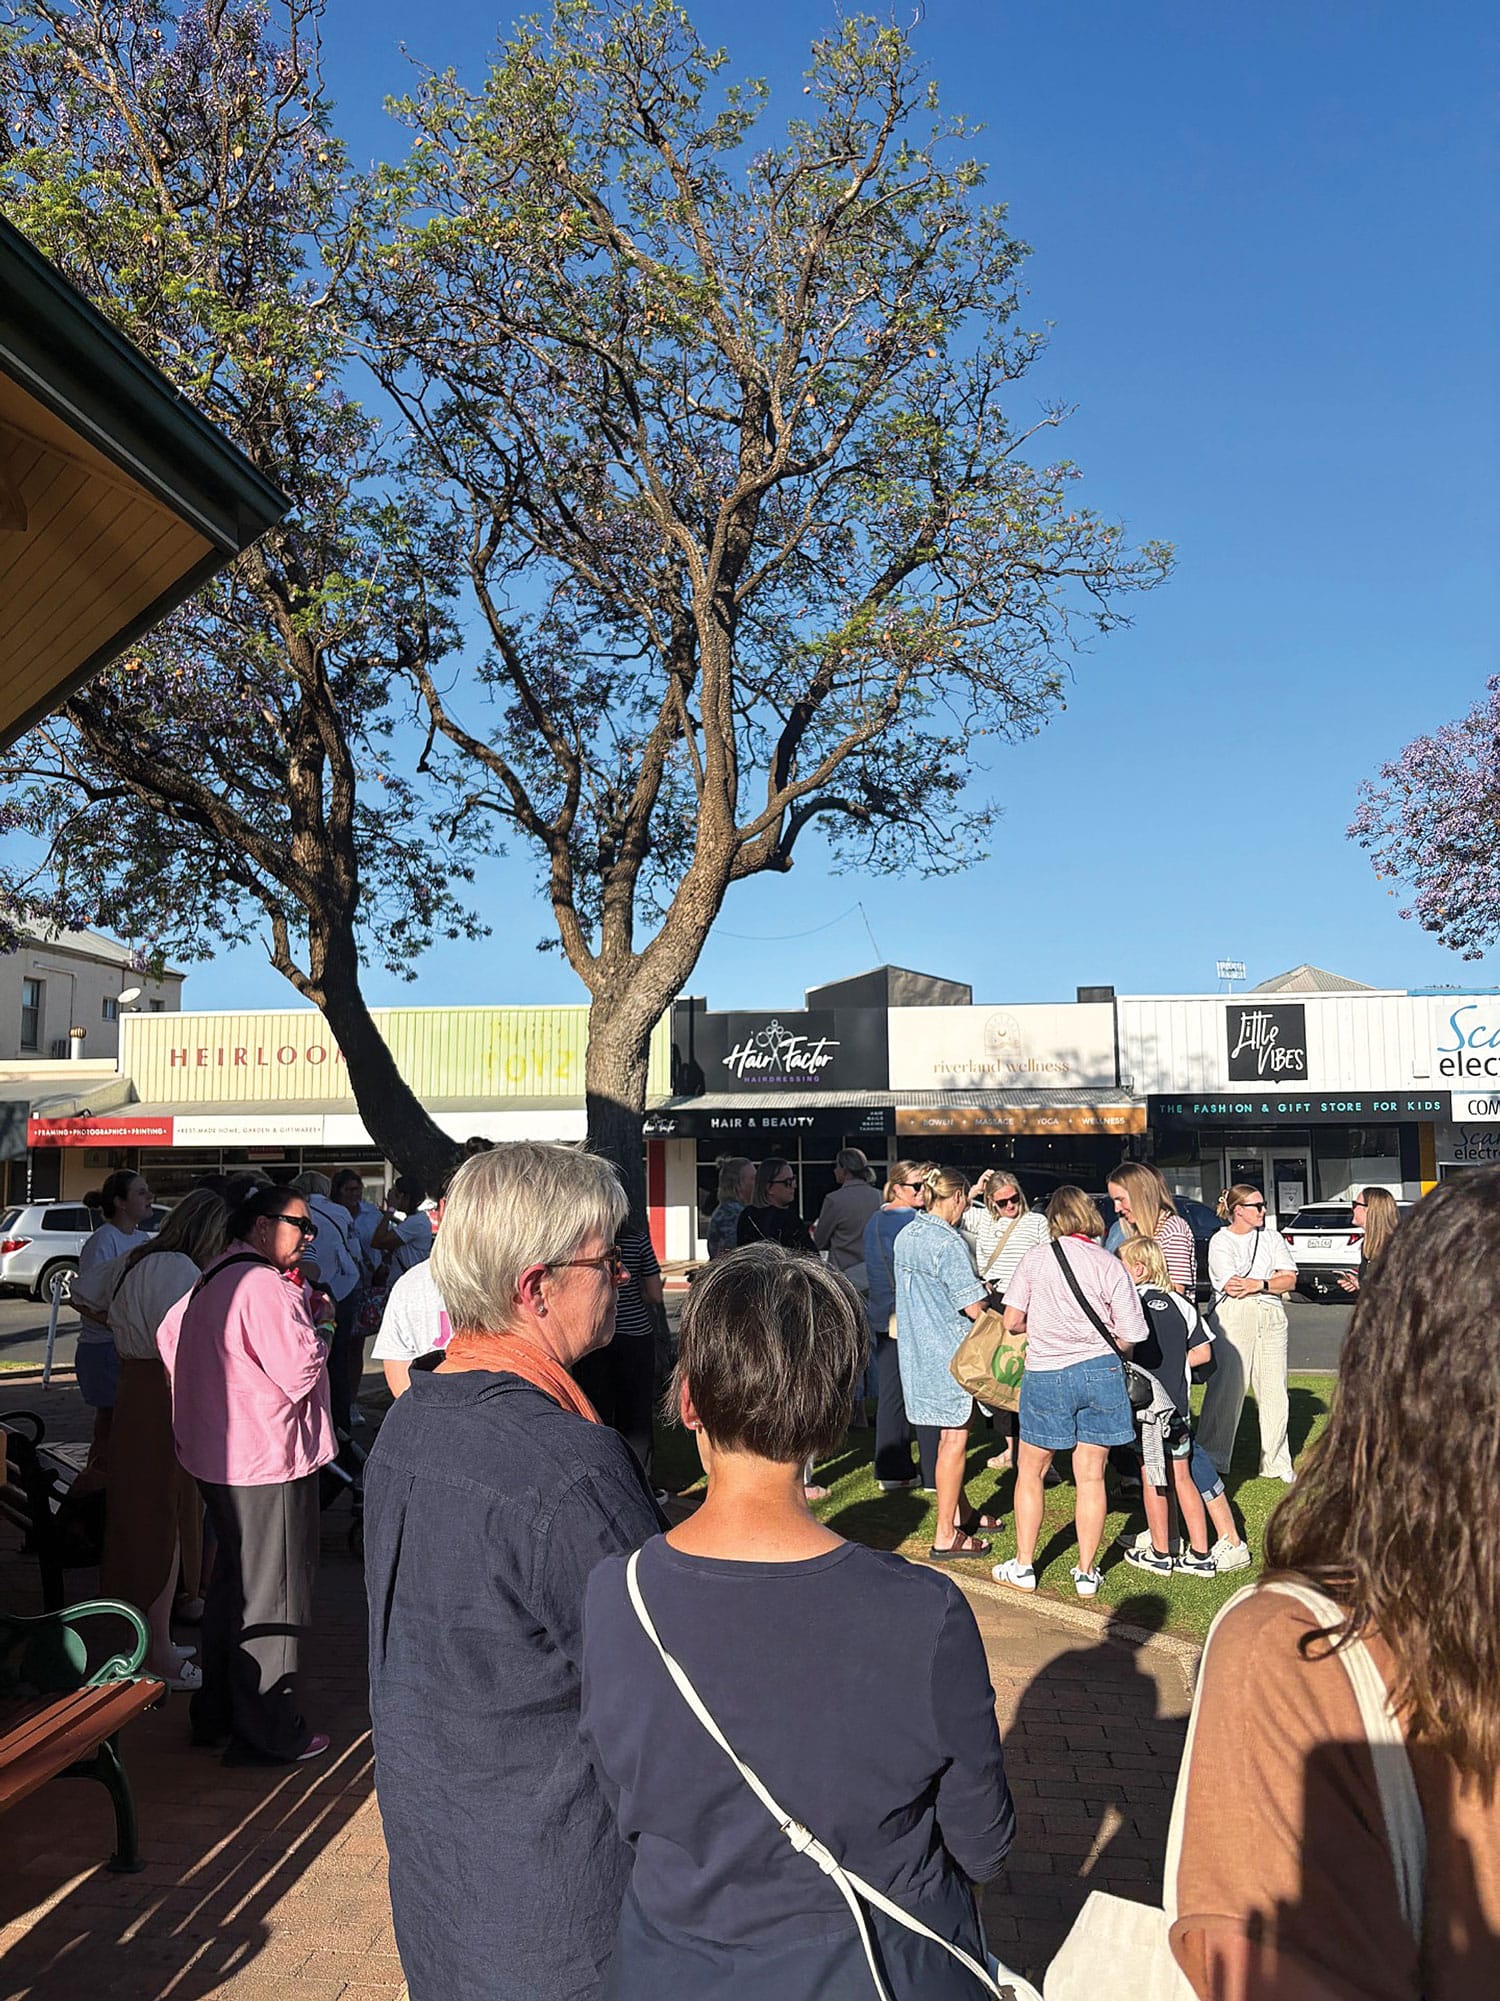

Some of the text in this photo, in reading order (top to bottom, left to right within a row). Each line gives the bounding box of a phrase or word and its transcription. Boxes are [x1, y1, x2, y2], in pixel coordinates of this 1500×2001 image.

[1231, 1010, 1280, 1059] Little
[722, 1036, 841, 1078] Hair Factor
[1257, 1042, 1304, 1075] VIBES
[1439, 1050, 1500, 1077] elec
[932, 1058, 1070, 1073] riverland wellness
[1159, 1101, 1441, 1114] THE FASHION & GIFT STORE FOR KIDS
[711, 1117, 815, 1128] HAIR & BEAUTY
[975, 1118, 1015, 1126] MASSAGE
[1036, 1117, 1060, 1125] YOGA
[1081, 1117, 1126, 1125] WELLNESS
[73, 1128, 127, 1136] PHOTOGRAPHICS
[131, 1127, 163, 1135] PRINTING
[1454, 1146, 1500, 1160] electr
